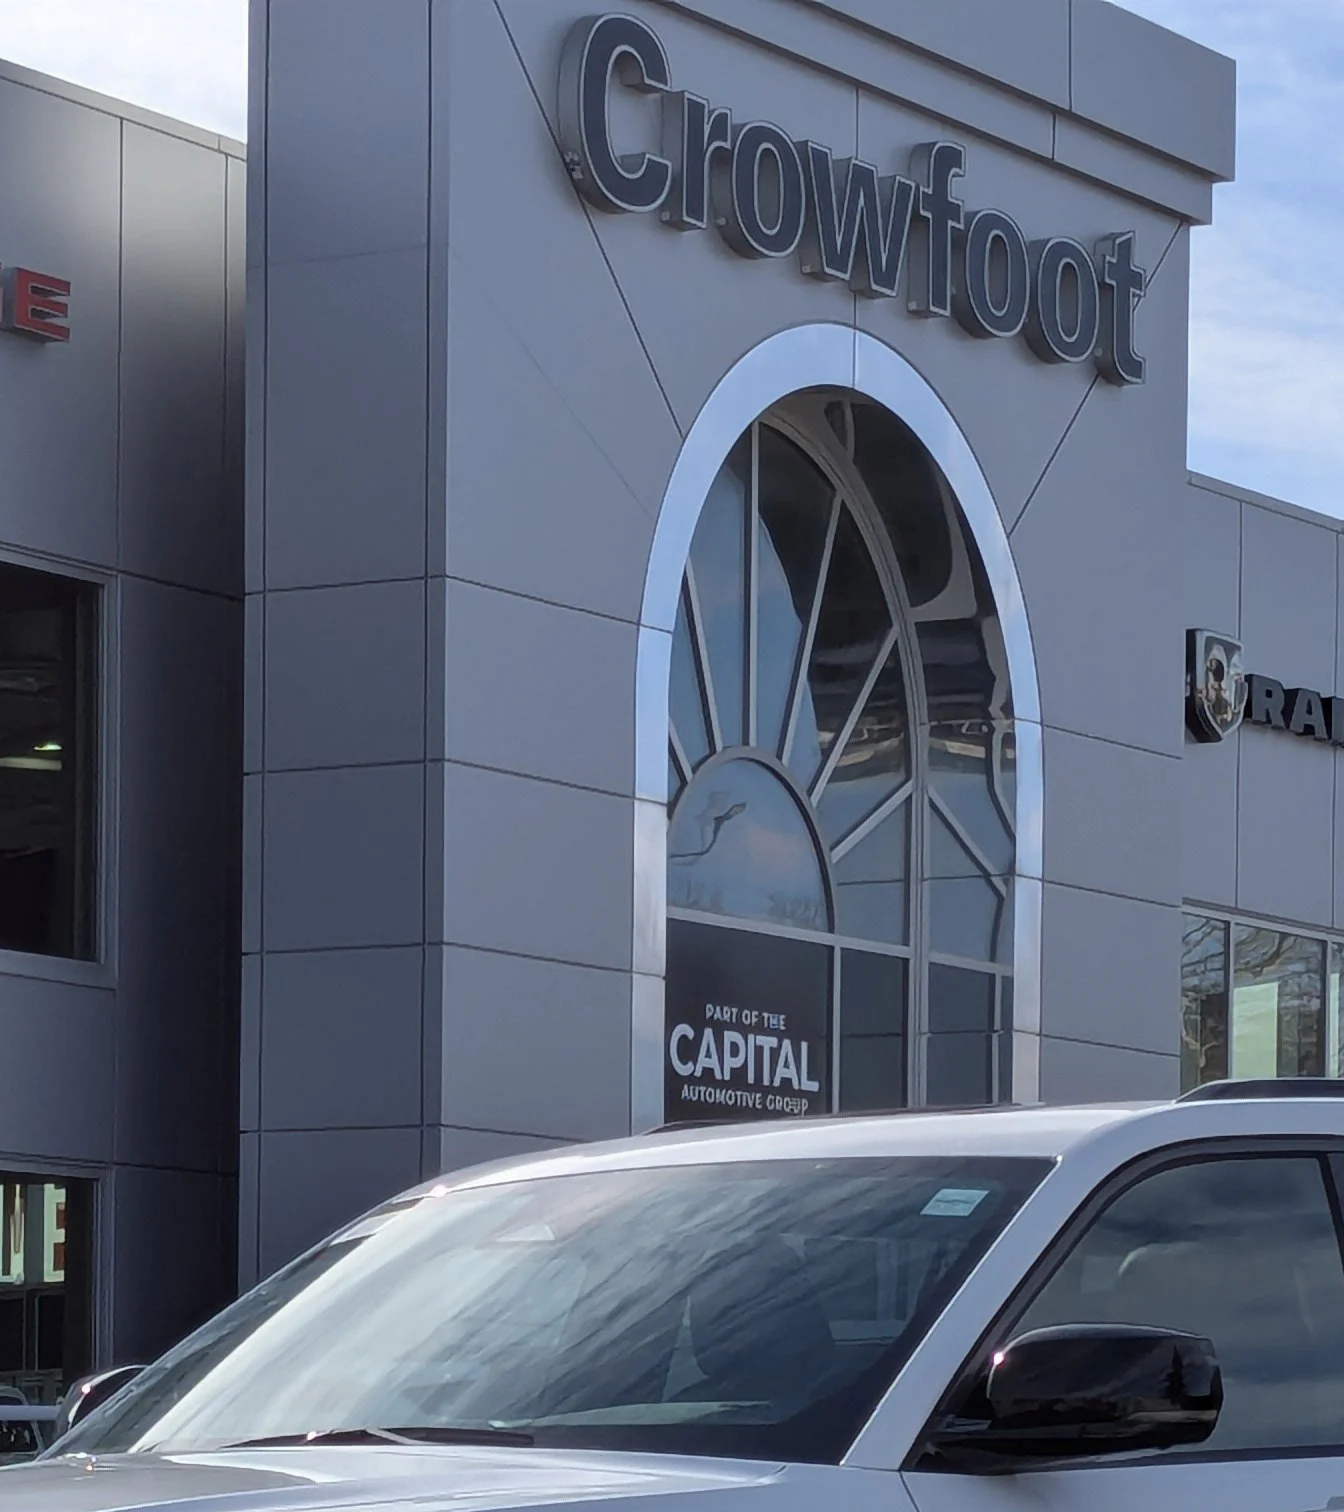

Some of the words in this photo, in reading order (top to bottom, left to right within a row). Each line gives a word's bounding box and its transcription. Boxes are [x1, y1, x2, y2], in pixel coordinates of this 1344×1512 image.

[572, 12, 1146, 386] Crowfoot
[705, 1003, 738, 1024] PART
[742, 1009, 760, 1027] OF
[763, 1012, 787, 1031] THE
[668, 1022, 820, 1093] CAPITAL
[681, 1083, 763, 1110] AUTOMOTIVE
[766, 1093, 809, 1117] GROUP
